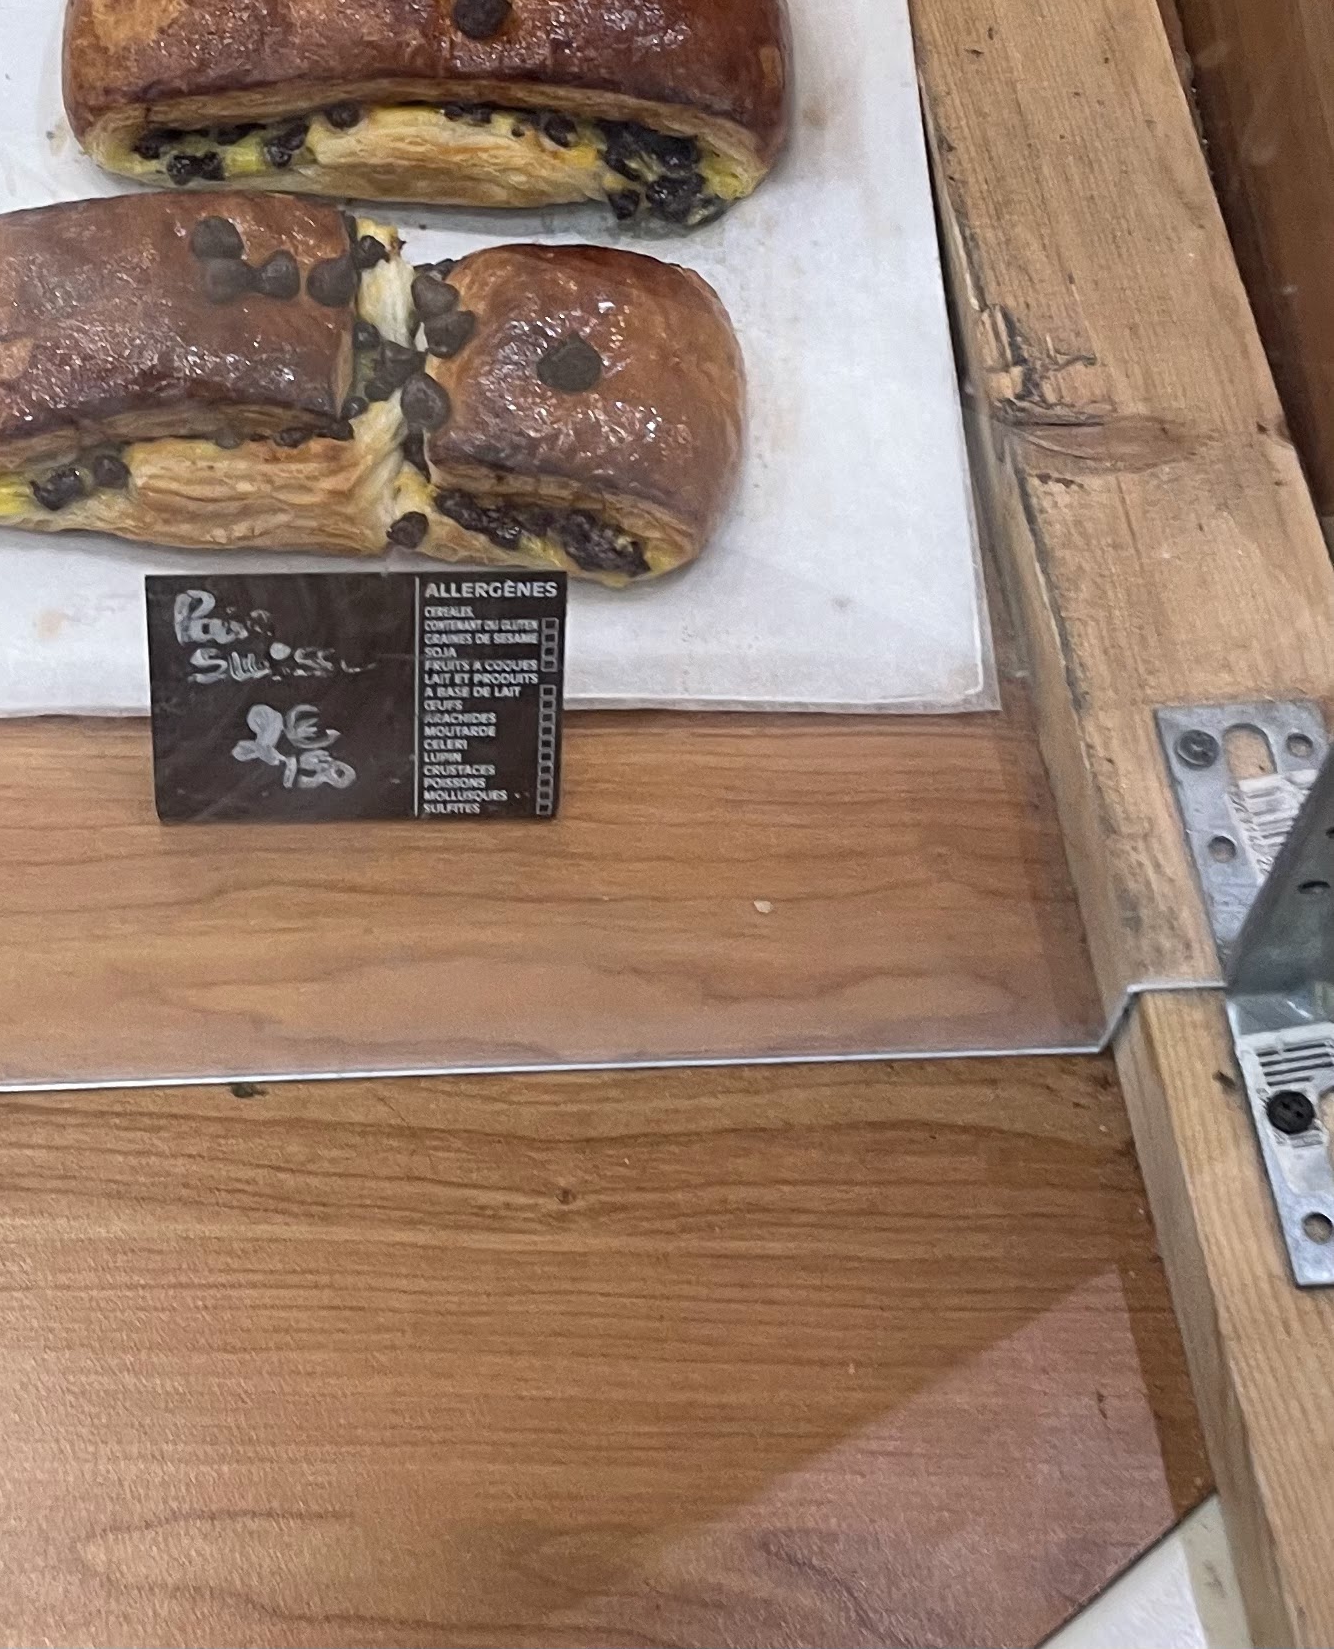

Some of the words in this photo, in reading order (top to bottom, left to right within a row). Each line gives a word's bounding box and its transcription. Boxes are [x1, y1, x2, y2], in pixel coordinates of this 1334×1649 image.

[425, 579, 558, 598] ALLERGÈNES
[474, 633, 491, 645] DE
[424, 646, 458, 658] SOJA
[424, 659, 470, 671] FRUITS
[484, 659, 539, 671] COQUES
[424, 673, 452, 685] LAIT
[454, 673, 471, 685] ET
[472, 672, 539, 685] PRODUITS
[436, 686, 470, 698] BASE
[472, 686, 492, 698] DE
[494, 686, 522, 698] LAIT
[423, 725, 497, 737] MOUTARDE
[423, 752, 462, 763] LUPIN
[423, 777, 487, 789] POISSONS
[423, 790, 508, 802] MOLLUSQUES
[423, 803, 481, 814] SULFITES
